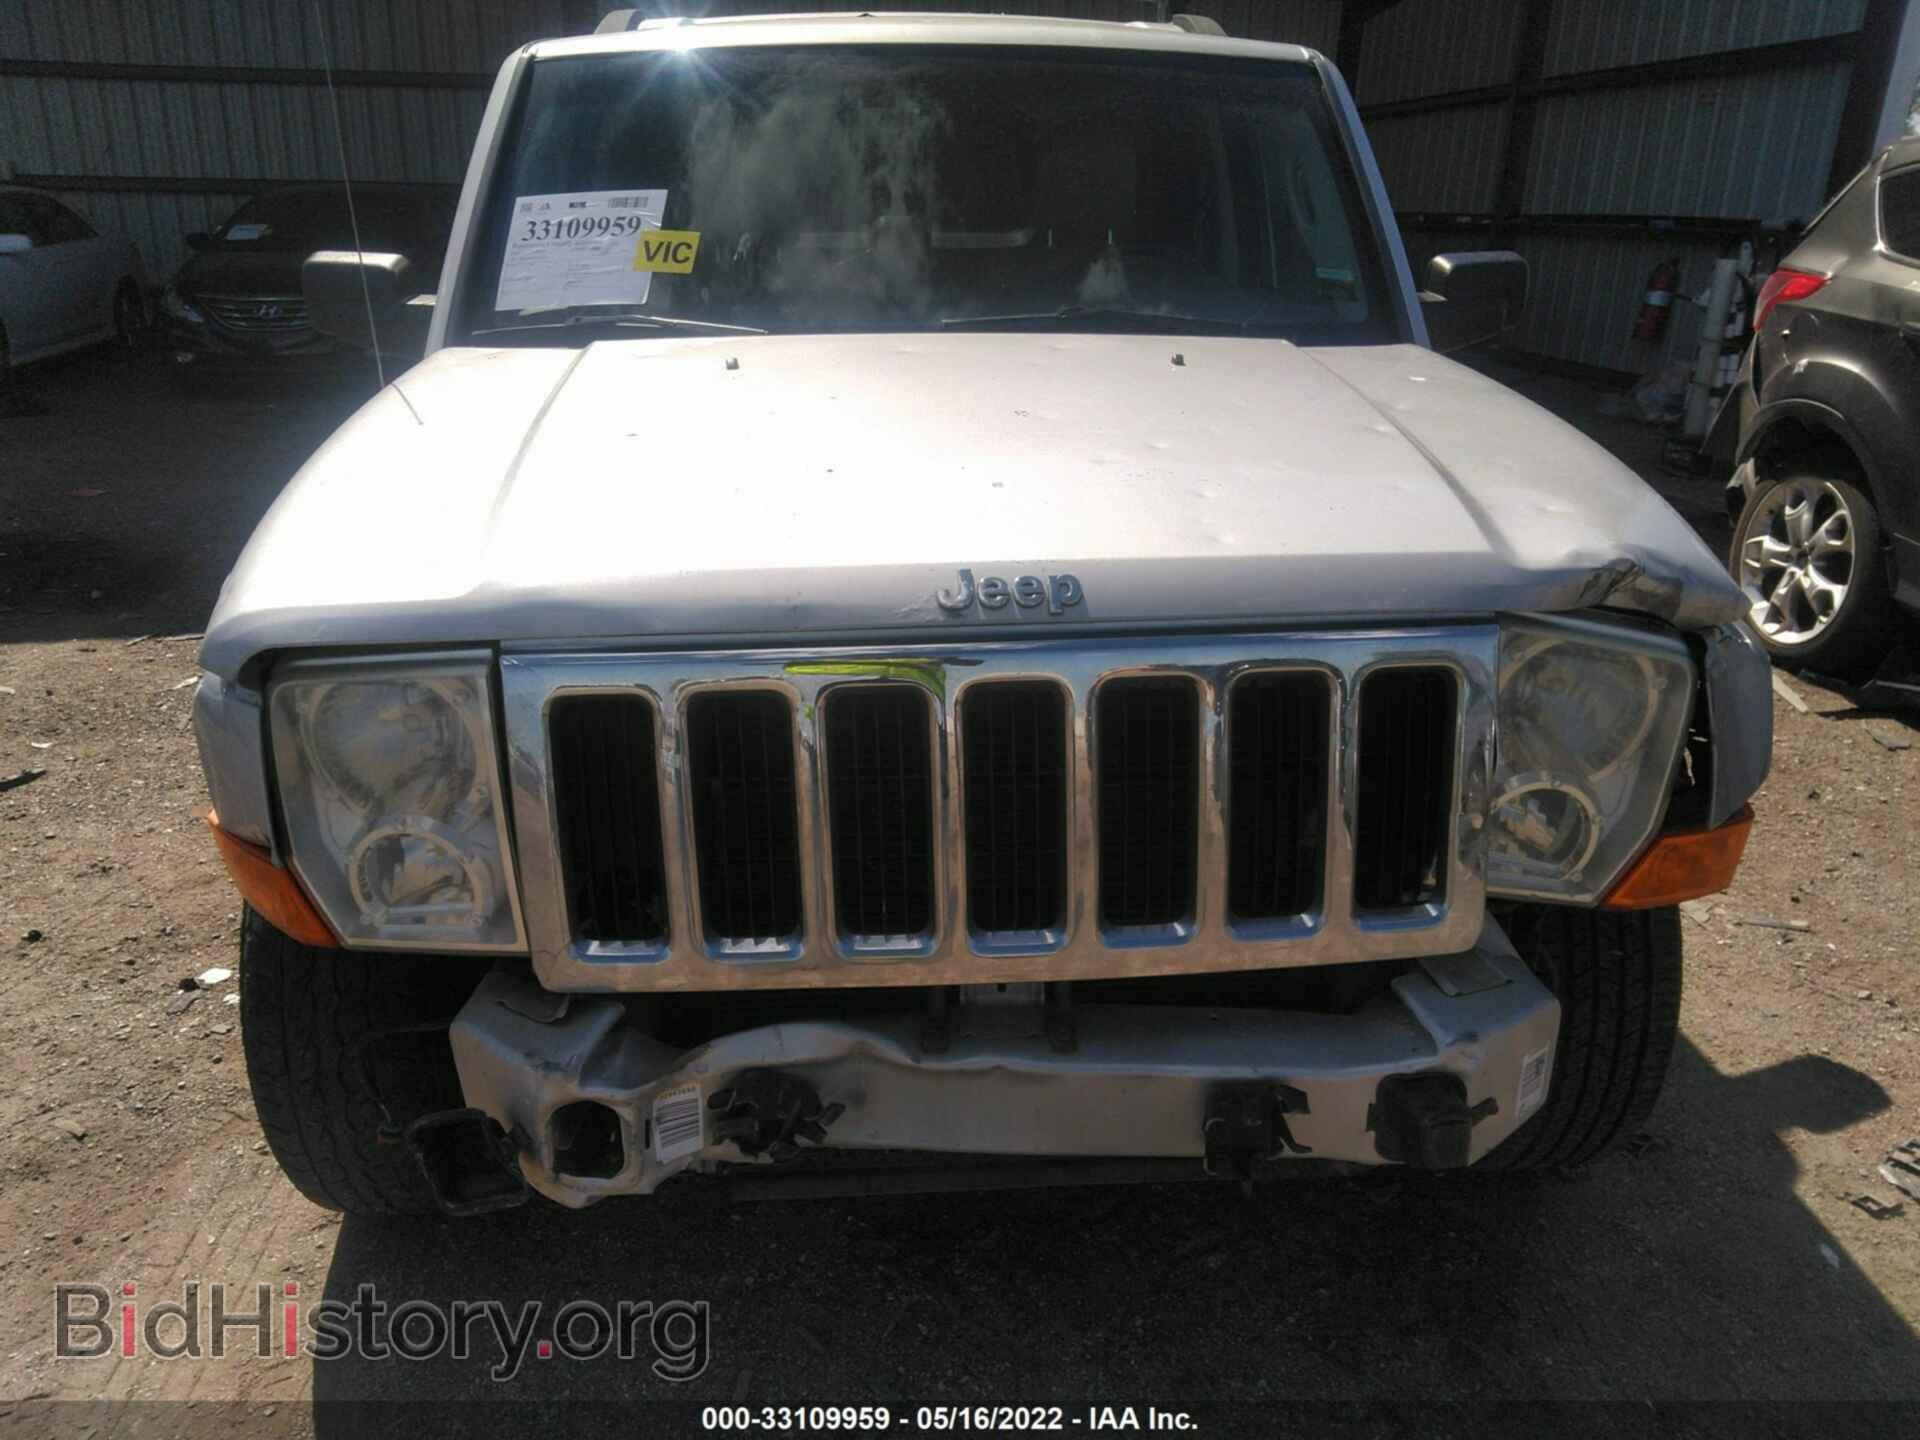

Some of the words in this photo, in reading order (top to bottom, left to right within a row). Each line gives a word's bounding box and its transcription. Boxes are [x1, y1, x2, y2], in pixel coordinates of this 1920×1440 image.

[521, 215, 642, 242] 33109959
[643, 239, 693, 264] VIC
[936, 568, 1083, 615] Jeep
